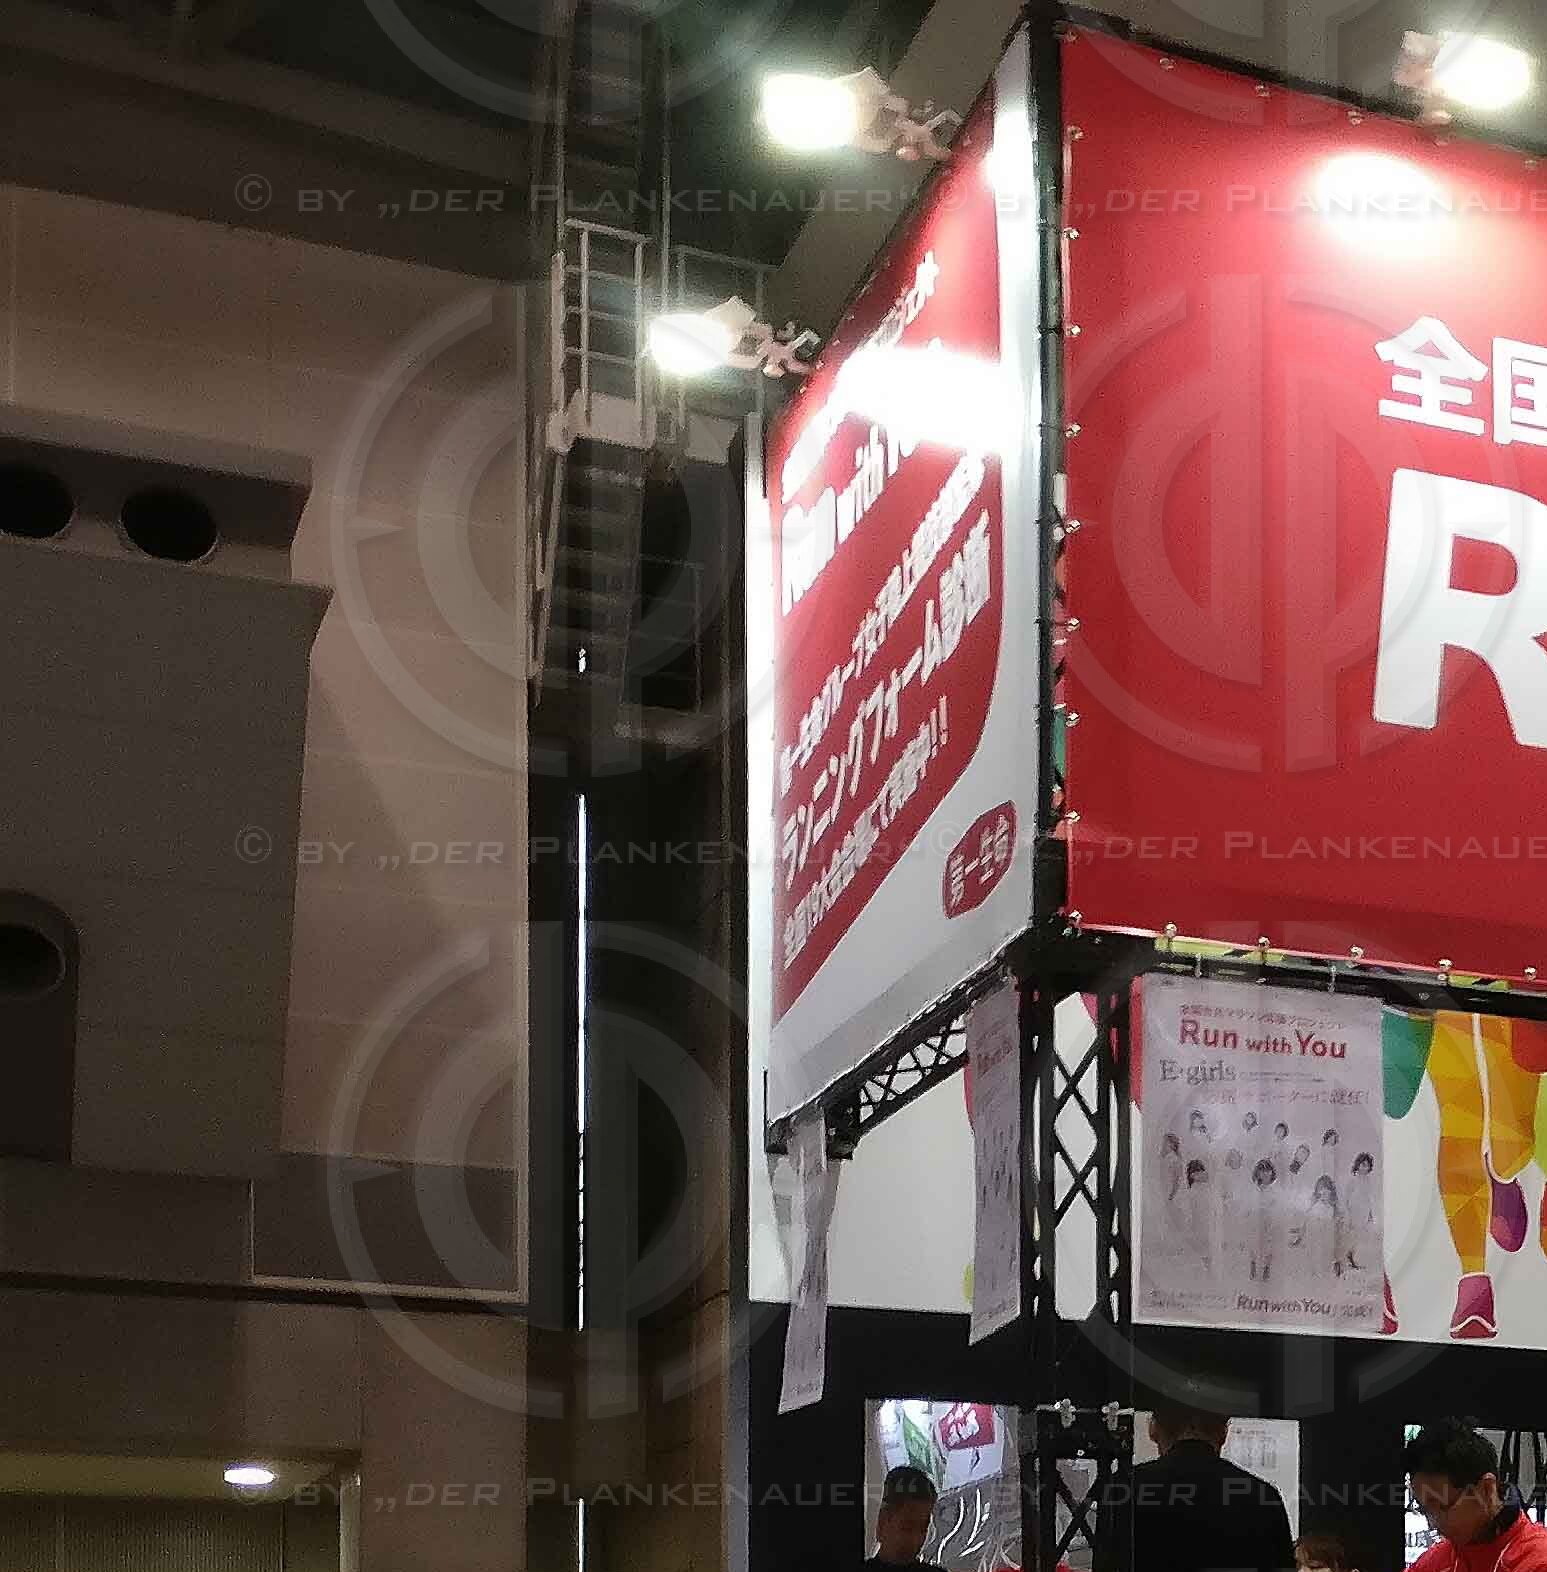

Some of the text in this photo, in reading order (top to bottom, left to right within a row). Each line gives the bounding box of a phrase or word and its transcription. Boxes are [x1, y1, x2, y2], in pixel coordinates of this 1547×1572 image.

[1179, 1018, 1347, 1059] Run with You
